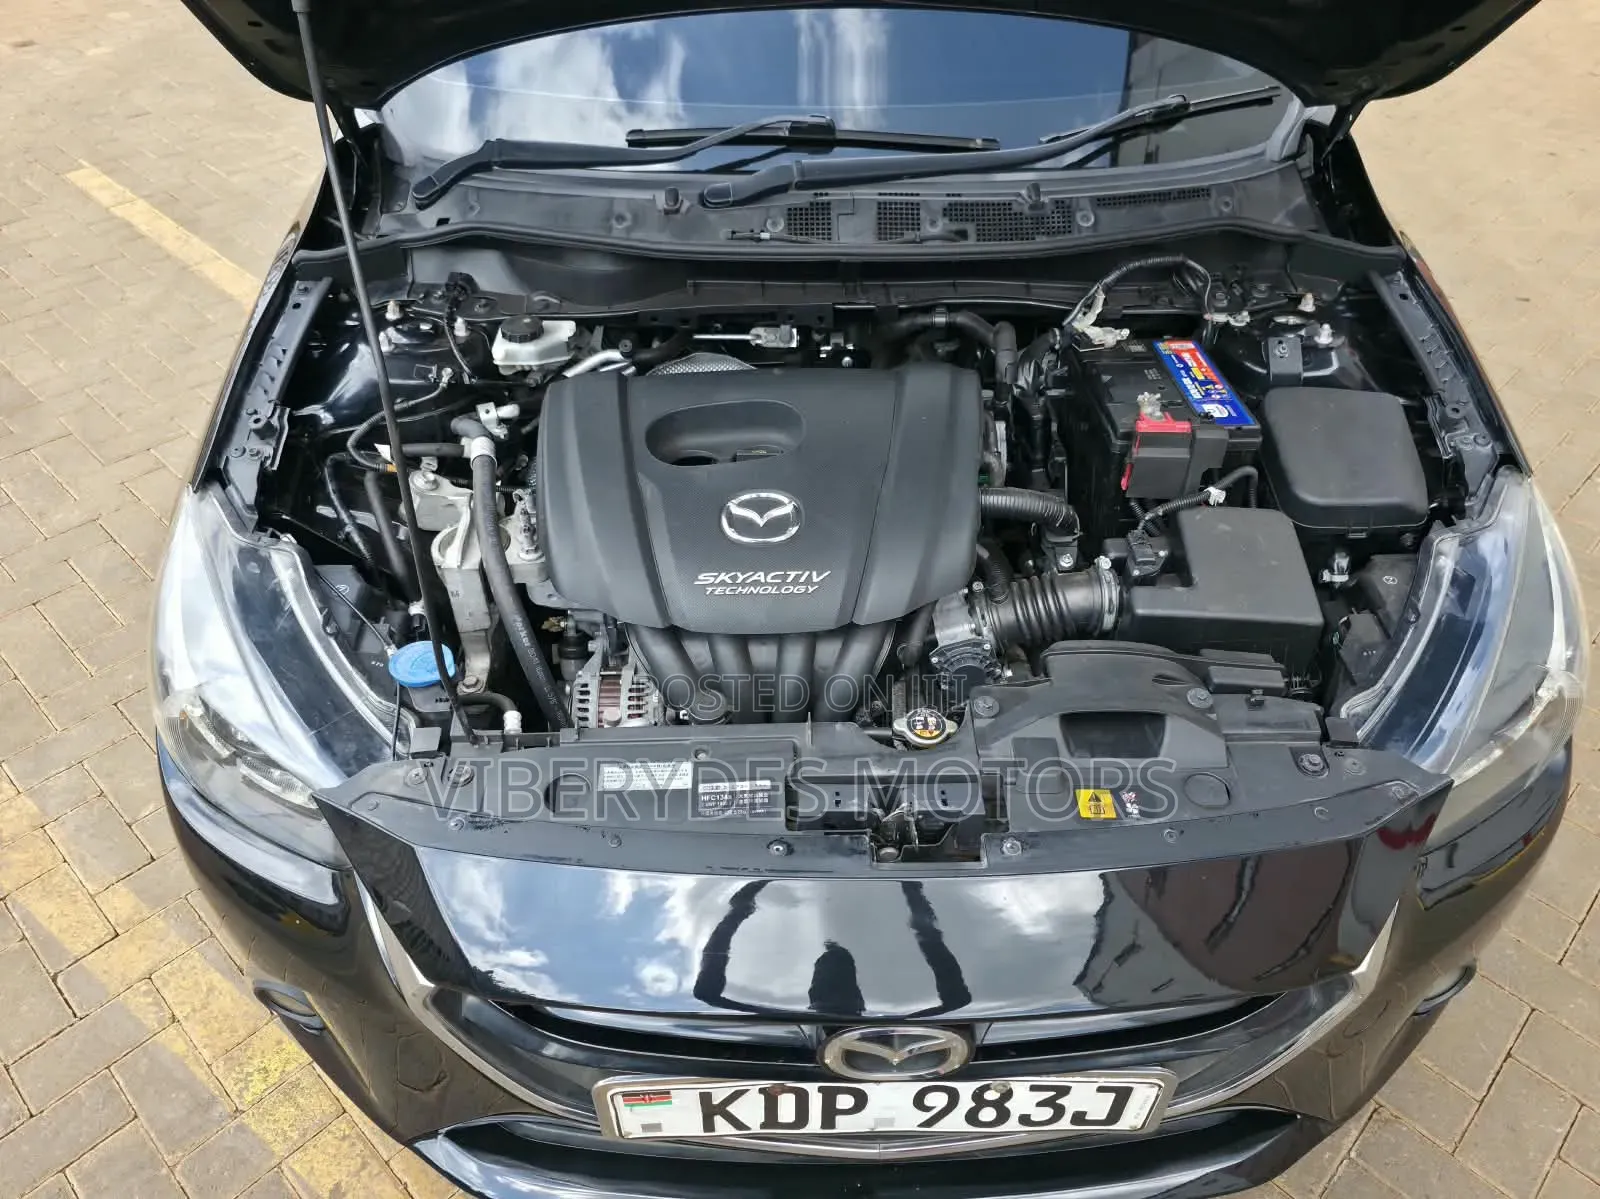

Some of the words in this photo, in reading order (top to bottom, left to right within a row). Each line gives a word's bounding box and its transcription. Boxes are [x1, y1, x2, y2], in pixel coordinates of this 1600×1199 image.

[694, 571, 831, 585] SKYACTIV
[705, 585, 818, 595] TECHNOLOGY
[699, 1084, 869, 1133] KDP
[912, 1083, 1134, 1129] 983J
